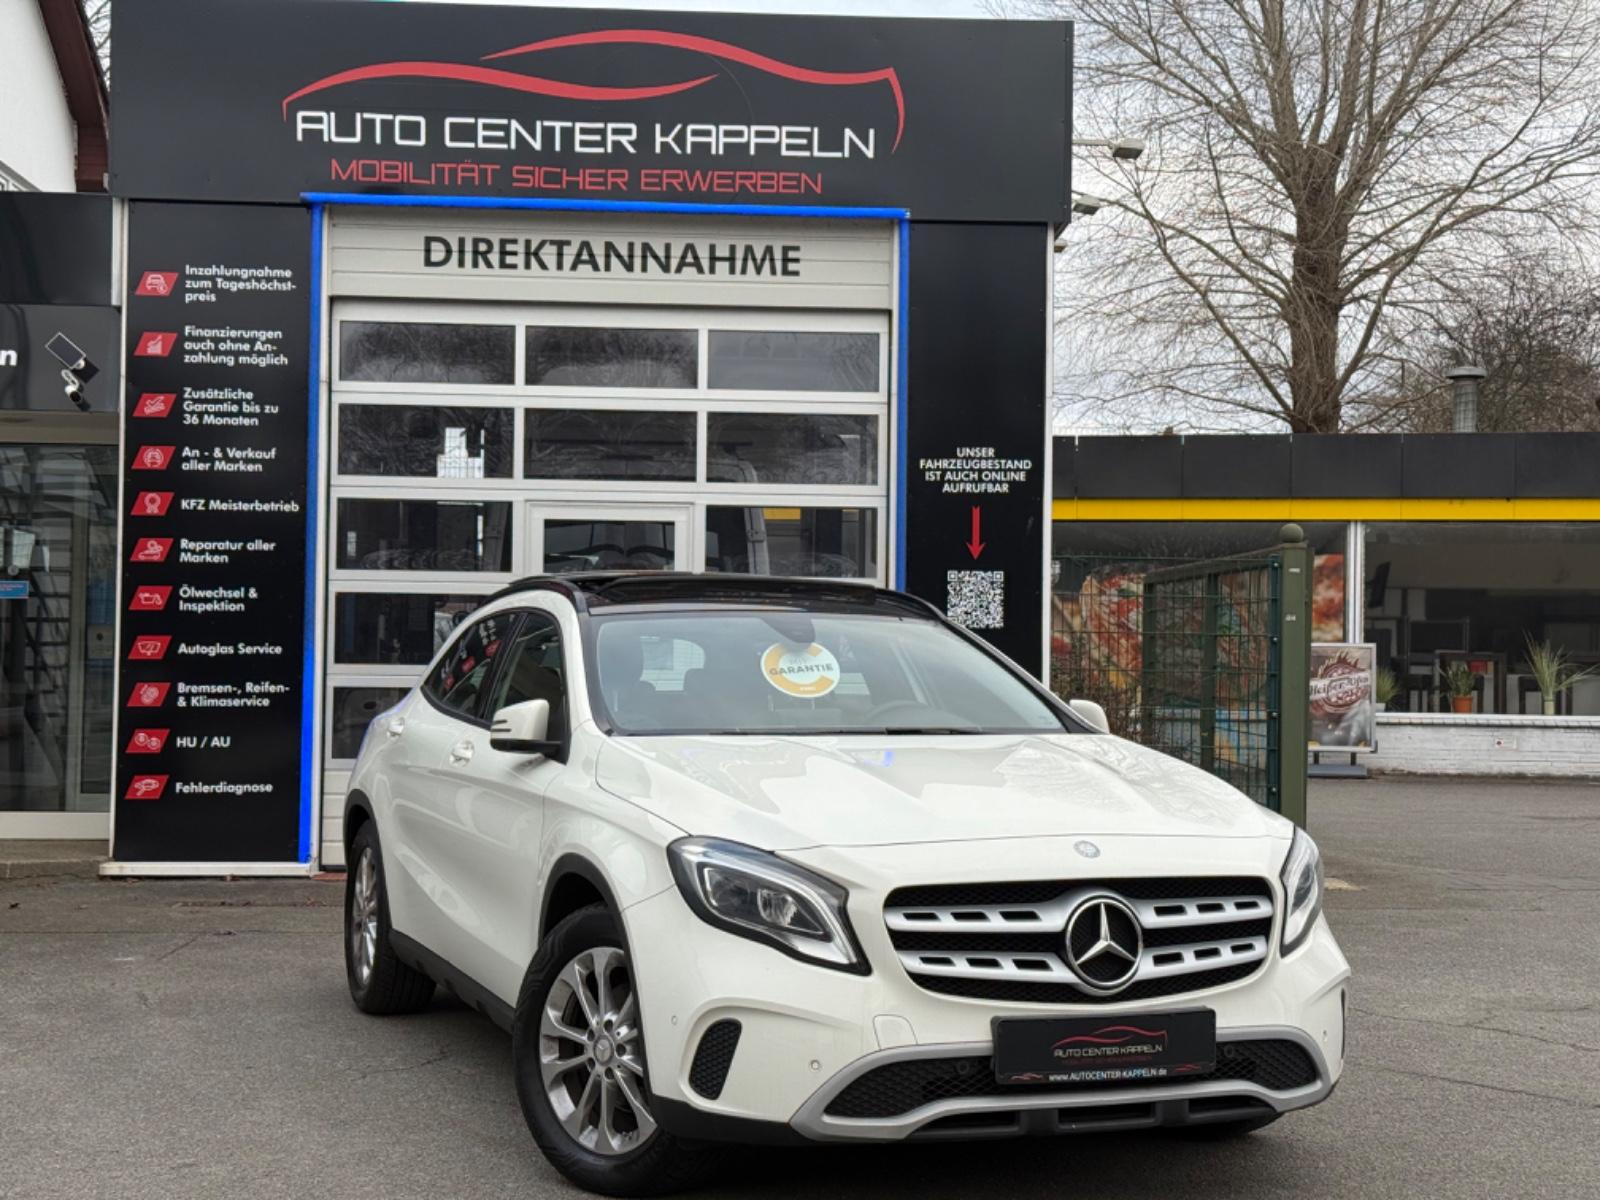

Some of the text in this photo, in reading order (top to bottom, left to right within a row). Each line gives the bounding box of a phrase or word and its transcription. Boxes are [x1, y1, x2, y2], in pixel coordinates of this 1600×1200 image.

[297, 111, 874, 158] AUTO CENTER KAPPELN
[331, 160, 822, 193] MOBILITÄT SICHER ERWERBEN
[424, 235, 801, 276] DIREKTANNAHME
[185, 265, 293, 279] Inzahlungnahme
[185, 278, 297, 291] zum Tageshöchst-
[185, 291, 216, 303] preis
[185, 326, 282, 340] Finanzierungen
[184, 340, 276, 351] auch ohne An-
[184, 352, 288, 367] zahlung möglich
[184, 387, 253, 400] Zusätzliche
[183, 401, 278, 413] Garantie bis zu
[183, 414, 258, 426] 36 Monaten
[182, 447, 200, 457] An
[214, 448, 222, 458] &
[227, 448, 276, 459] Verkauf
[957, 448, 994, 457] UNSER
[182, 461, 262, 471] aller Marken
[920, 459, 1032, 469] FAHRZEUGBESTAND
[925, 471, 1025, 481] IST AUCH ONLINE
[943, 483, 1008, 492] AUFRUFBAR
[182, 499, 299, 511] KFZ Meisterbetrieb
[180, 539, 275, 552] Reparatur aller
[180, 552, 228, 563] Marken
[179, 584, 257, 598] Ölwechsel &
[179, 600, 244, 613] Inspektion
[178, 643, 282, 656] Autoglas Service
[769, 663, 833, 675] GARANTIE
[178, 681, 290, 694] Bremsen-, Reifen-
[178, 695, 270, 707] & Klimaservice
[177, 737, 197, 747] HU
[211, 736, 230, 747] AU
[176, 782, 273, 795] Fehlerdiagnose
[1054, 1043, 1163, 1058] AUTO CENTER KAPPELN
